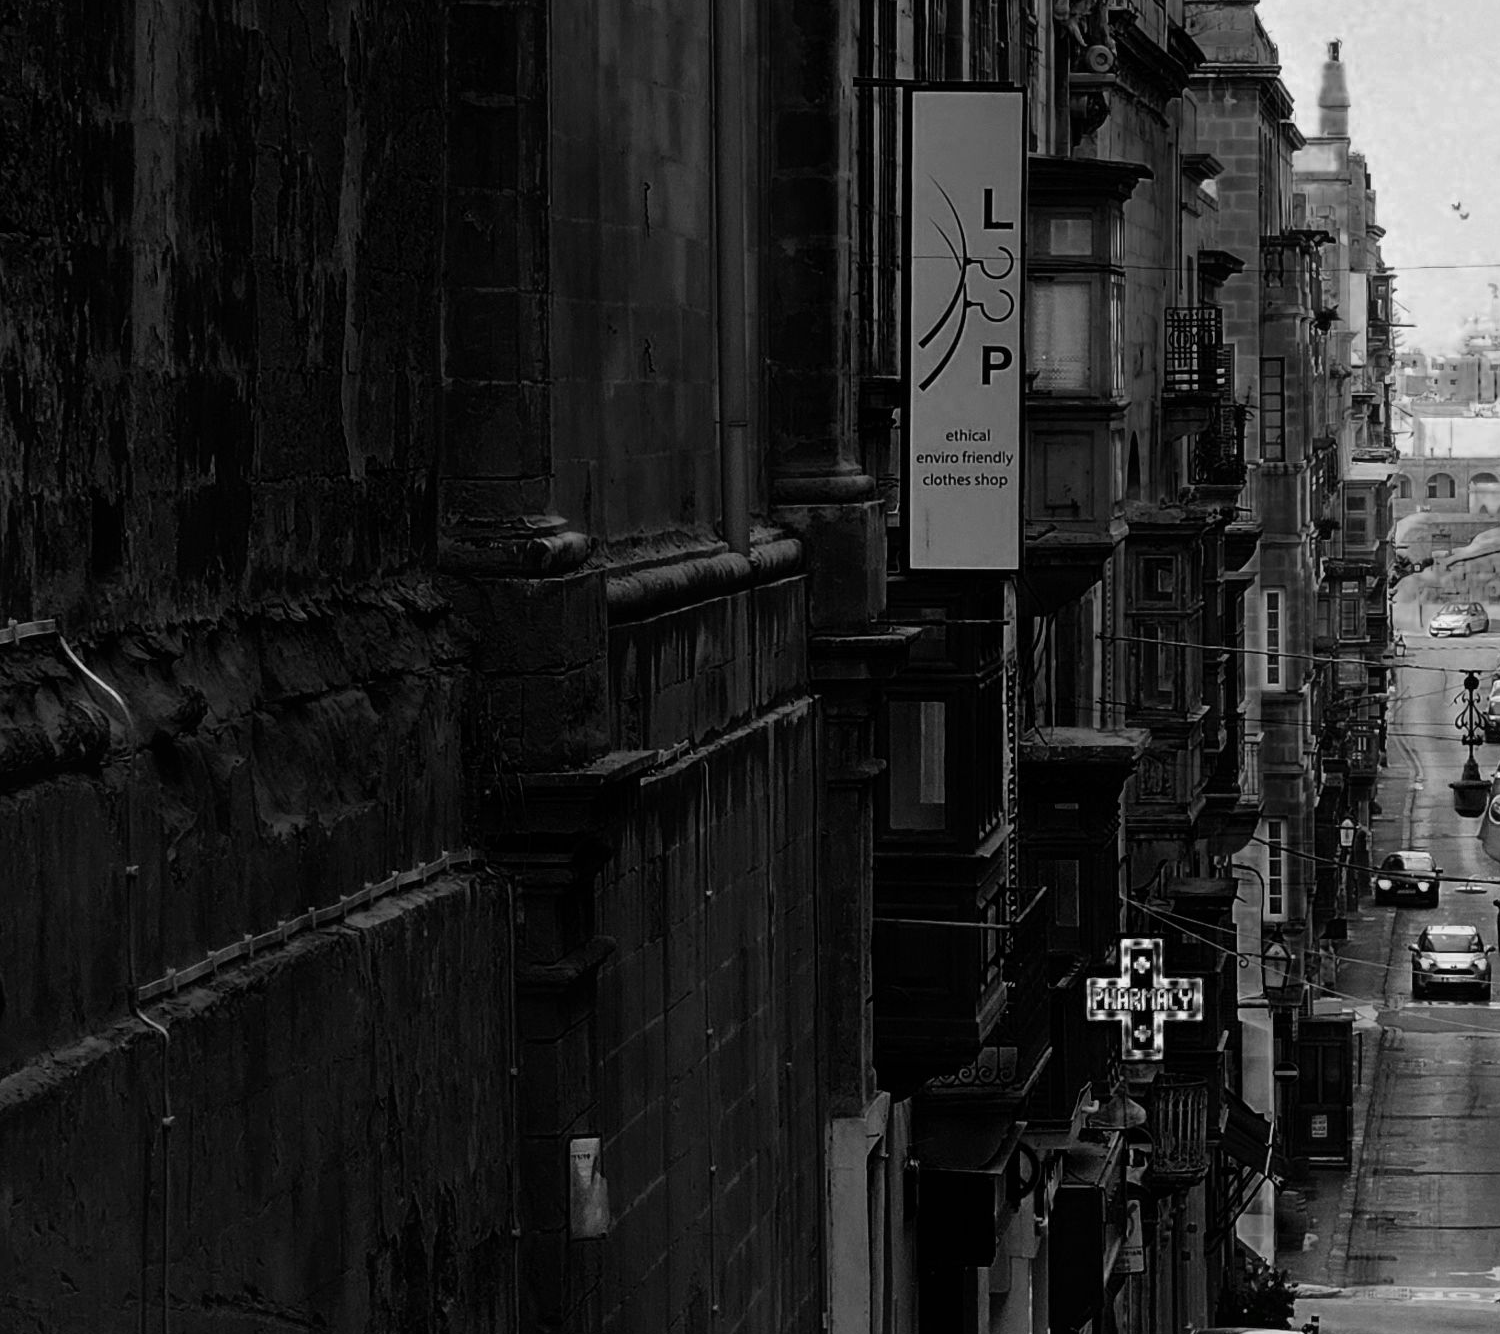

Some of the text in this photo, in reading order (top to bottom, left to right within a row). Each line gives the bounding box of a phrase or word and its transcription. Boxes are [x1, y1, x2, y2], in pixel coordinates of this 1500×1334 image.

[945, 429, 991, 442] ethical
[916, 450, 1014, 467] enviro friendly
[923, 473, 1008, 488] clothes shop
[1092, 988, 1193, 1011] PHARMACY
